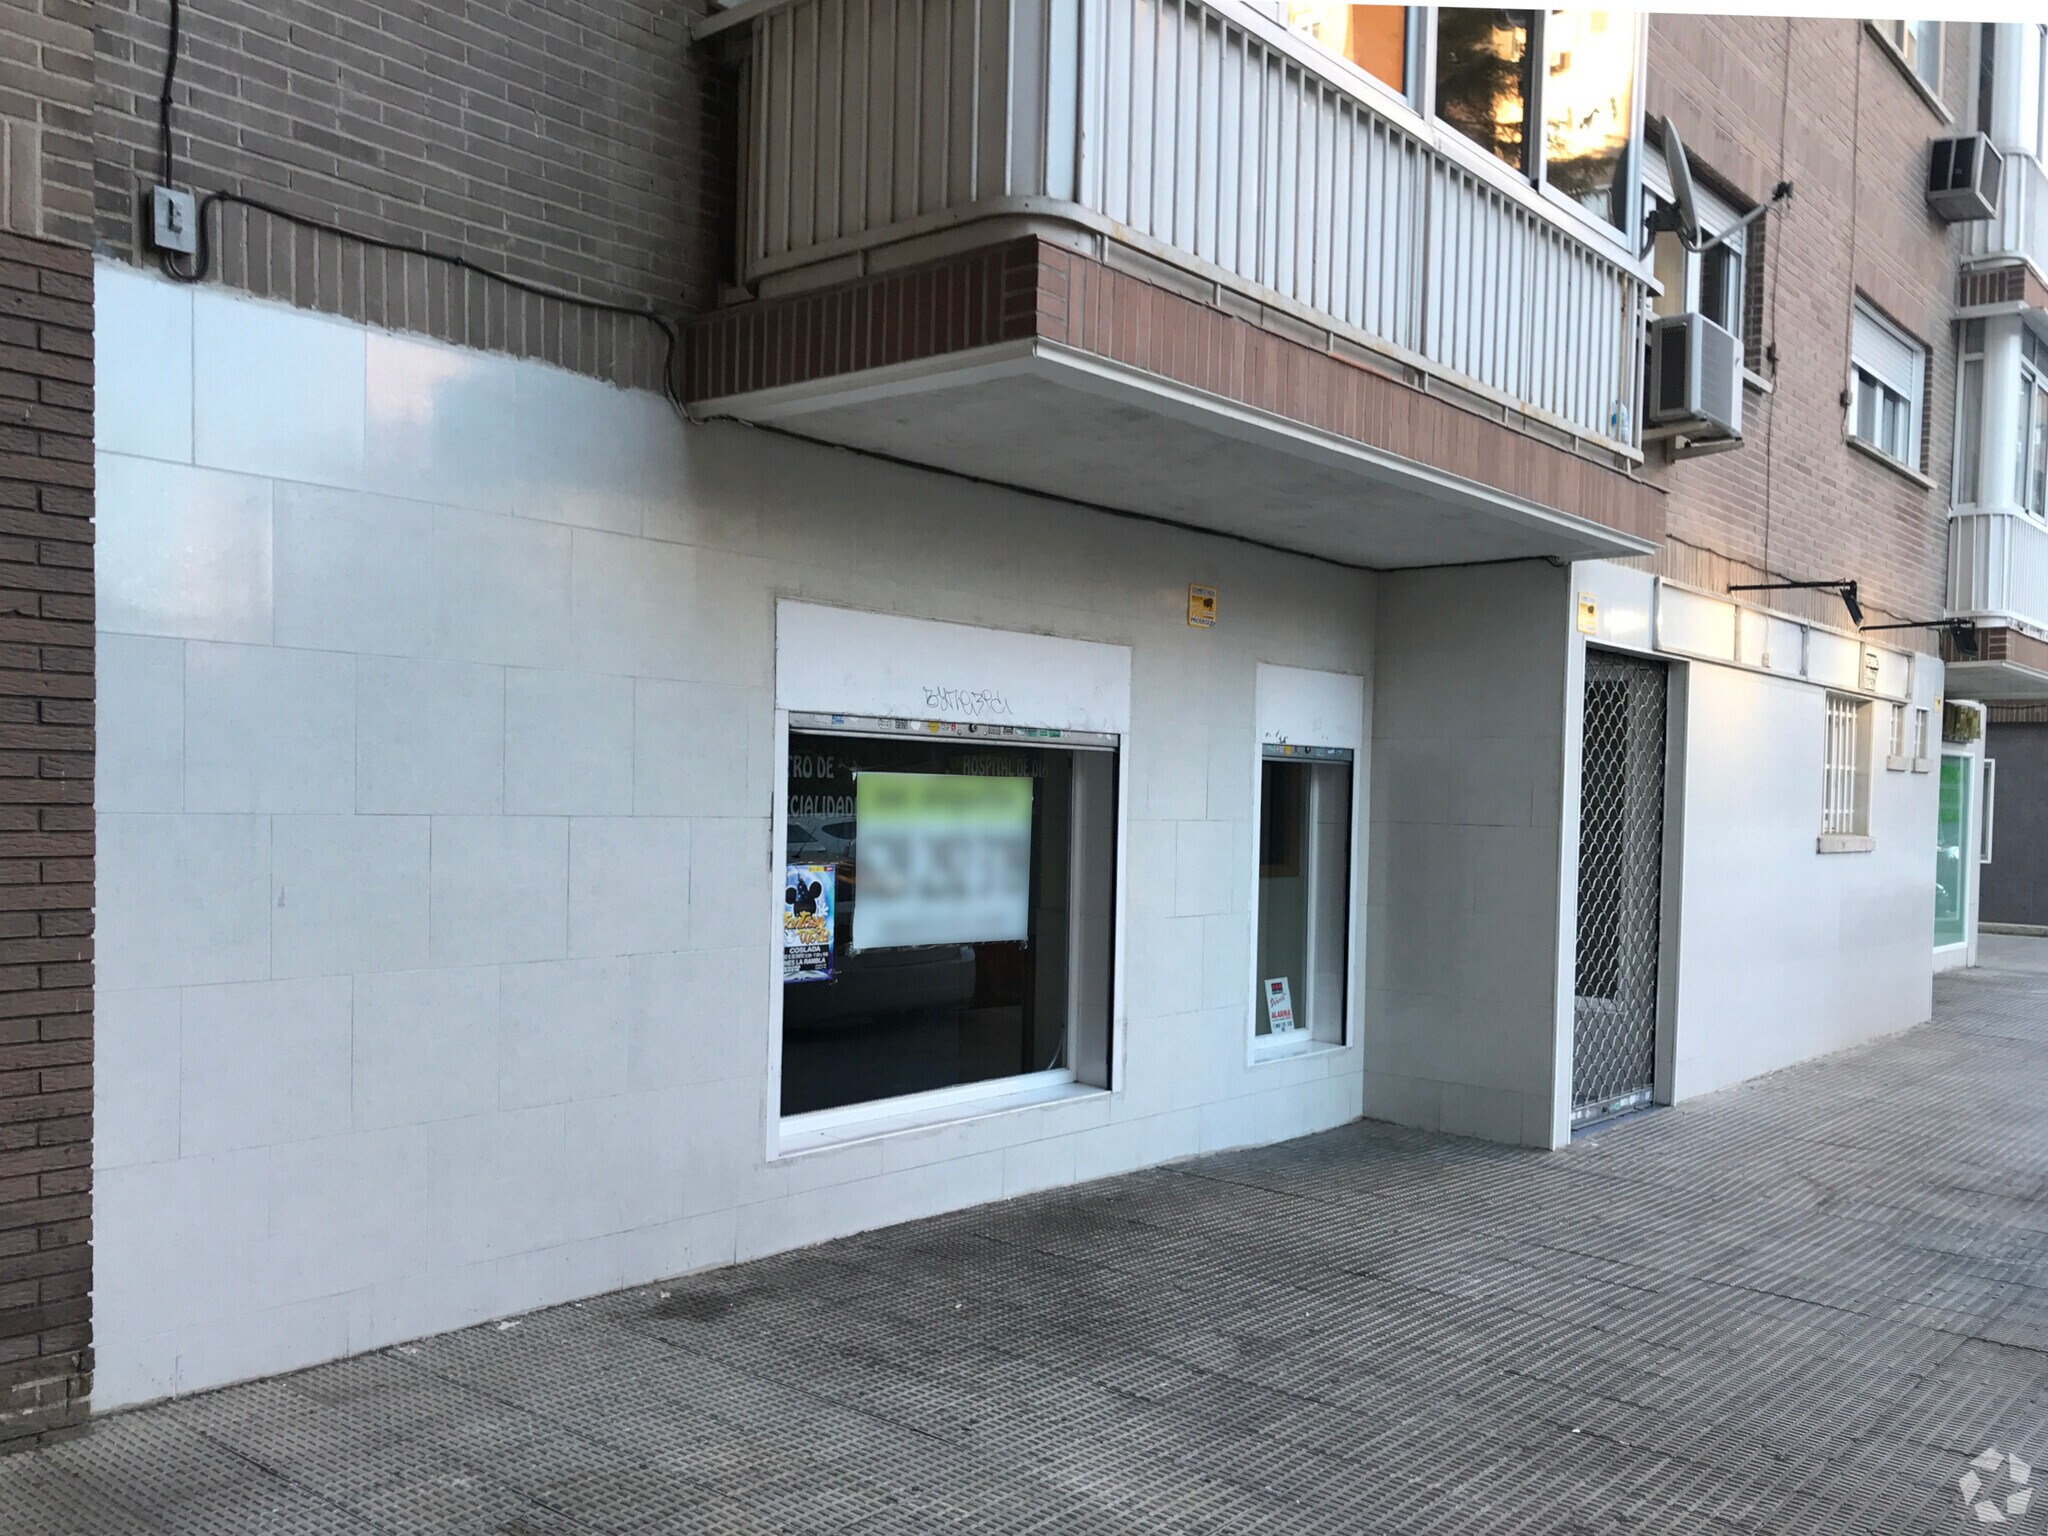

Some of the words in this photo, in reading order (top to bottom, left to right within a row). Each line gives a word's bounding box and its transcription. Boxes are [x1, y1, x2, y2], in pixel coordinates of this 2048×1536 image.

[817, 756, 834, 779] DE
[963, 755, 1014, 777] HOSPITAL
[1017, 758, 1030, 777] DE
[788, 794, 857, 817] CIALIDAD
[789, 946, 821, 954] COSLADA
[796, 958, 803, 966] LA
[804, 957, 826, 965] RAMBLA
[1272, 1009, 1290, 1018] ALARMA
